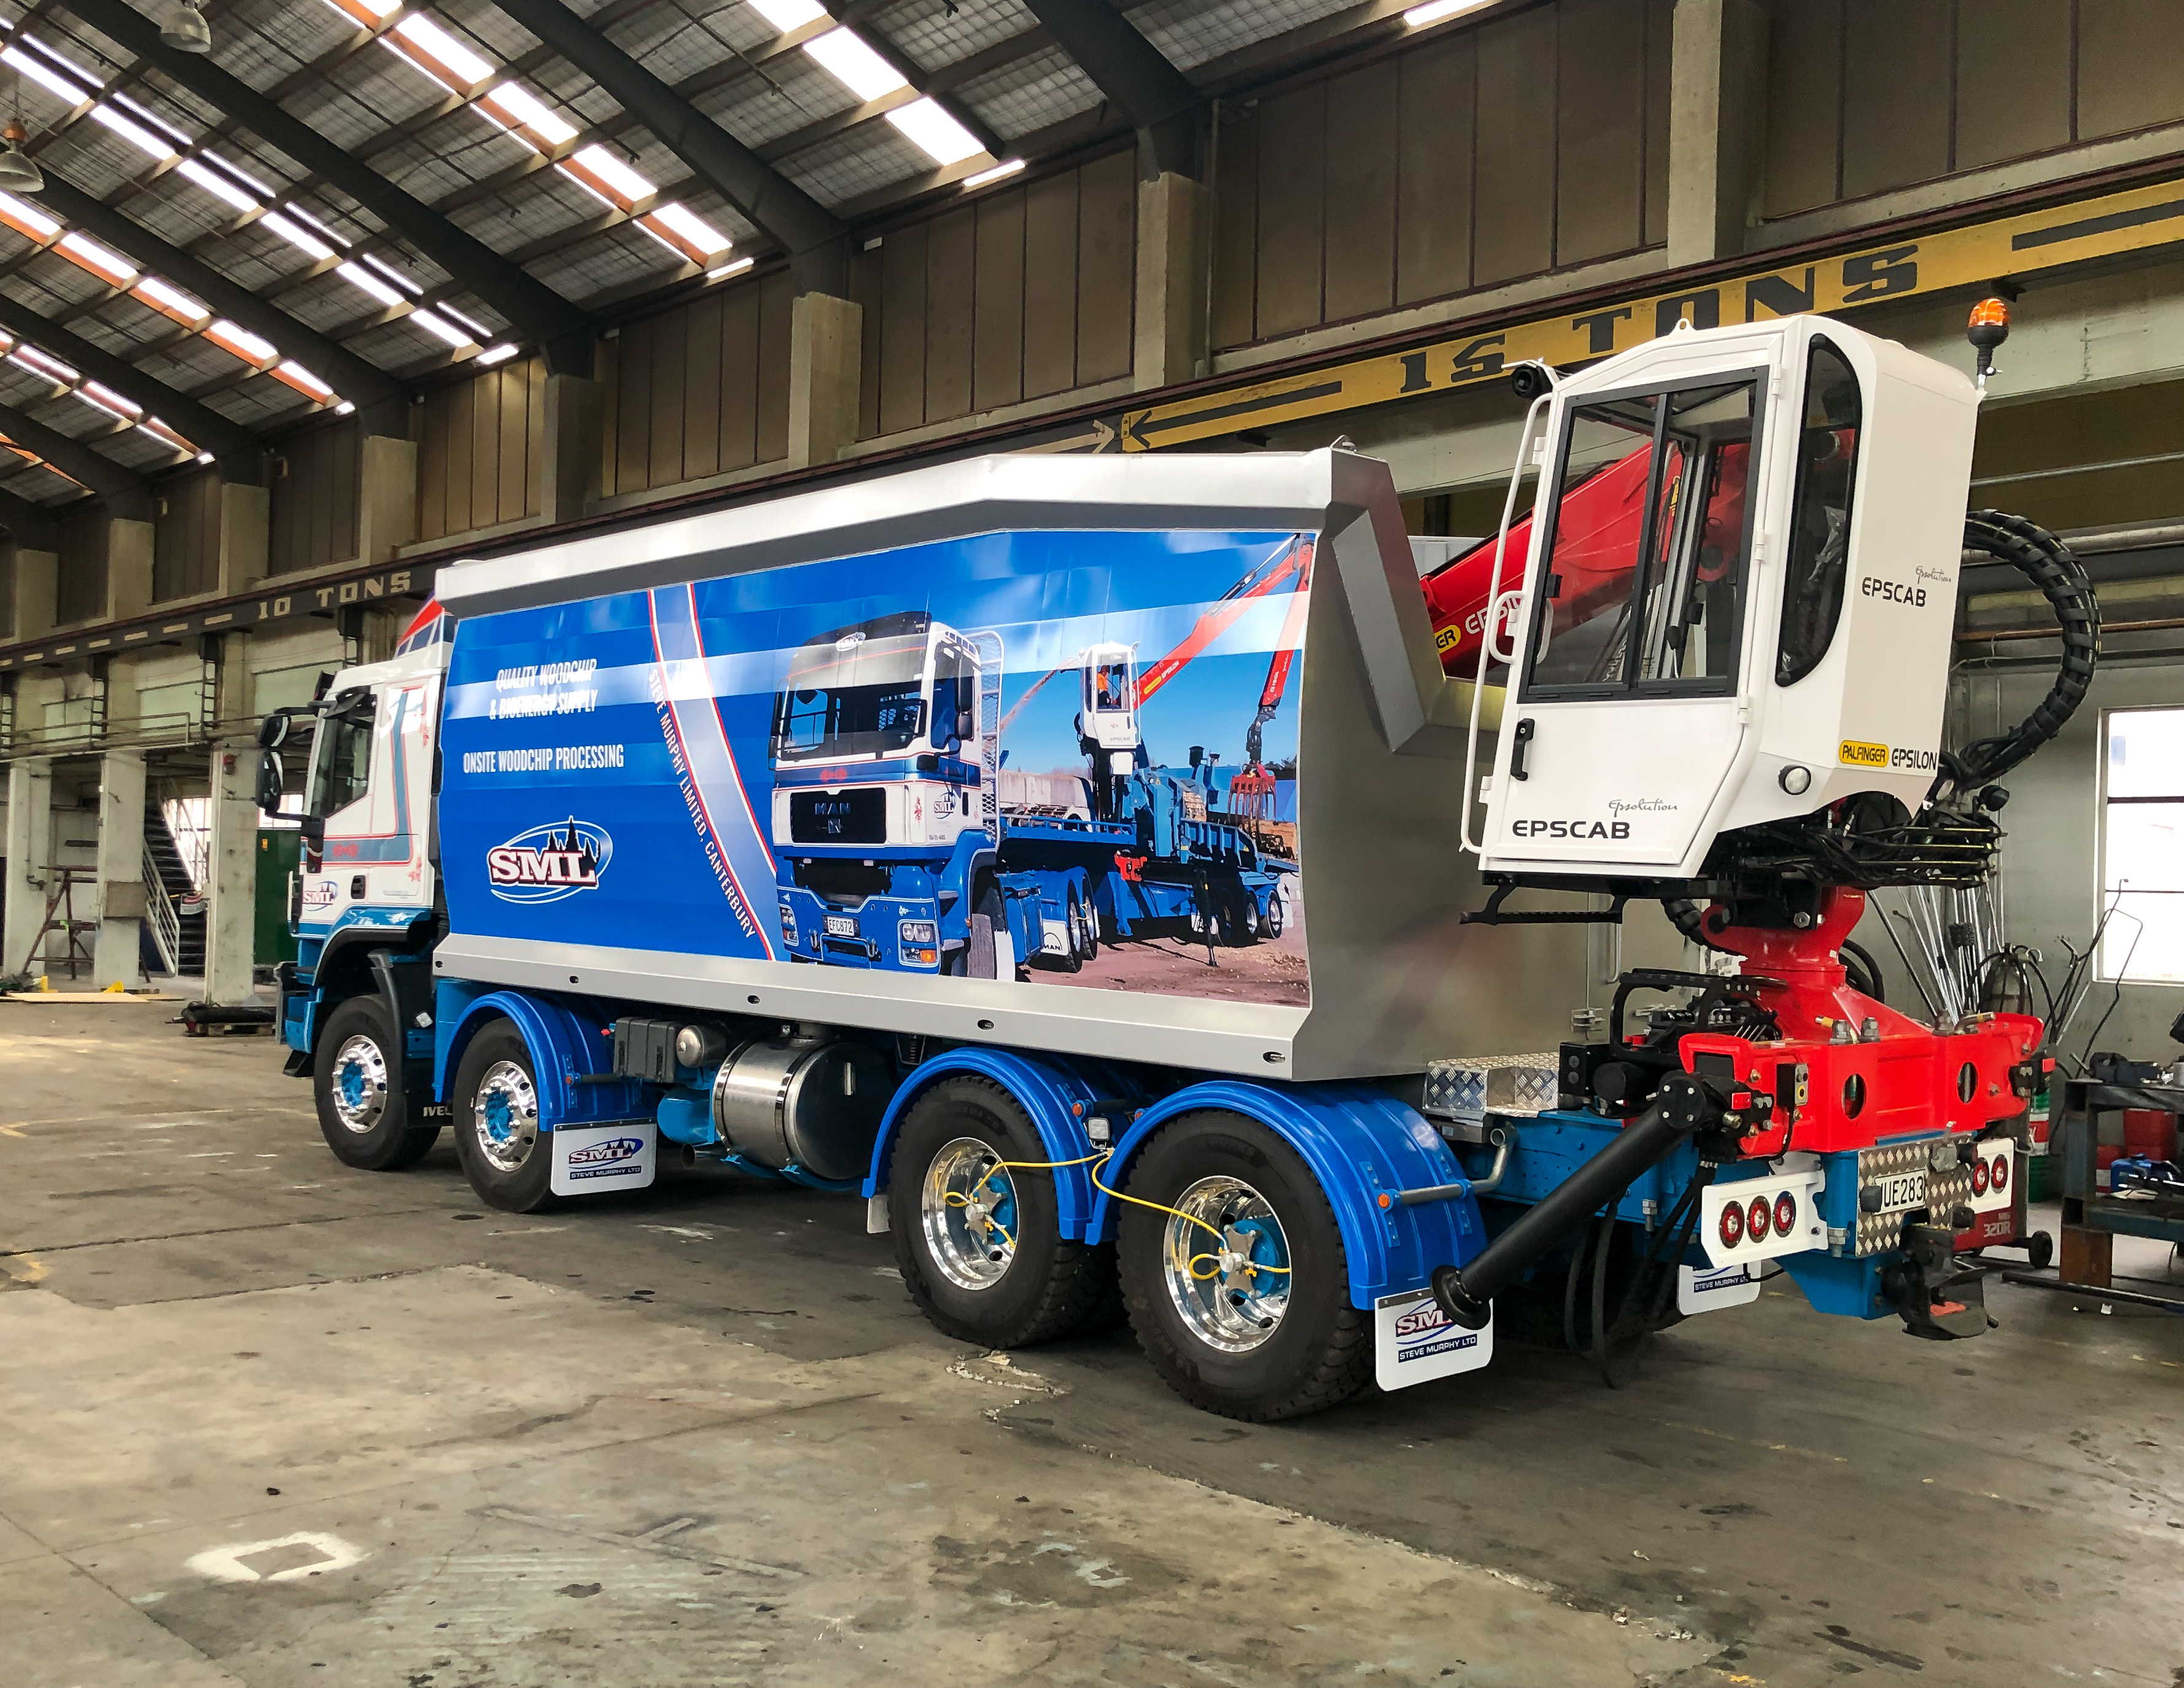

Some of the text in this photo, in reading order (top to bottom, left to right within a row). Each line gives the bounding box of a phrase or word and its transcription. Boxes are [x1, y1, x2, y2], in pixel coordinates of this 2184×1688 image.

[1572, 245, 1918, 354] TONS
[258, 571, 411, 620] 10 TONS
[1862, 577, 1927, 607] EPSCAB
[496, 658, 597, 693] QUALITY WOODCHIP
[489, 699, 497, 720] &
[556, 689, 599, 715] SUPPLY
[463, 744, 624, 774] ONSITE WOODCHIP PROCESSING
[1843, 745, 1938, 771] PALFINGER EPSILON
[649, 669, 756, 939] STEVE MURPHY LIMITED, CANTERBURY
[815, 803, 851, 815] MAN
[934, 801, 954, 814] SML
[1608, 798, 1678, 818] Epsolution
[1512, 820, 1631, 839] EPSCAB
[489, 847, 598, 888] SML
[303, 890, 333, 906] SML
[828, 919, 853, 934] EFC872
[569, 1147, 633, 1164] SML
[1695, 1281, 1713, 1291] STEVE
[1714, 1277, 1739, 1287] MURPHY
[1395, 1309, 1453, 1337] SM
[1399, 1337, 1476, 1360] STEVE MURPHY LTD
